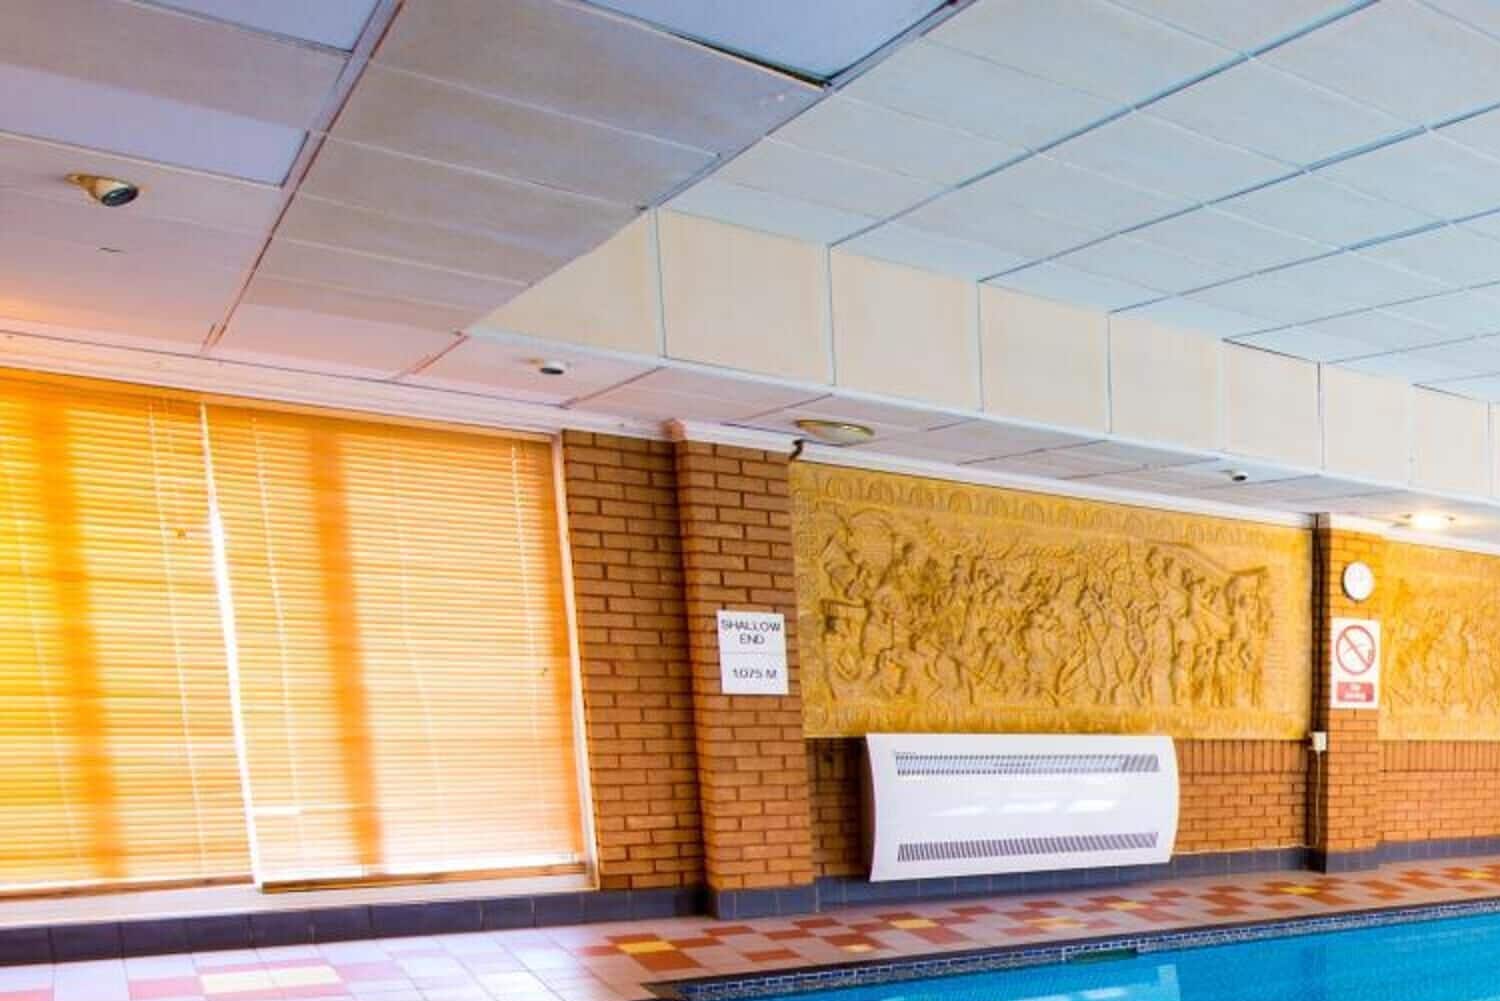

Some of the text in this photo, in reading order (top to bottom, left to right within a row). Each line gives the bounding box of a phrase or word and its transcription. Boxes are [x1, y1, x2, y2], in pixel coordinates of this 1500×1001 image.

[720, 618, 781, 632] SHALLOW
[739, 633, 765, 645] END
[765, 668, 777, 679] M
